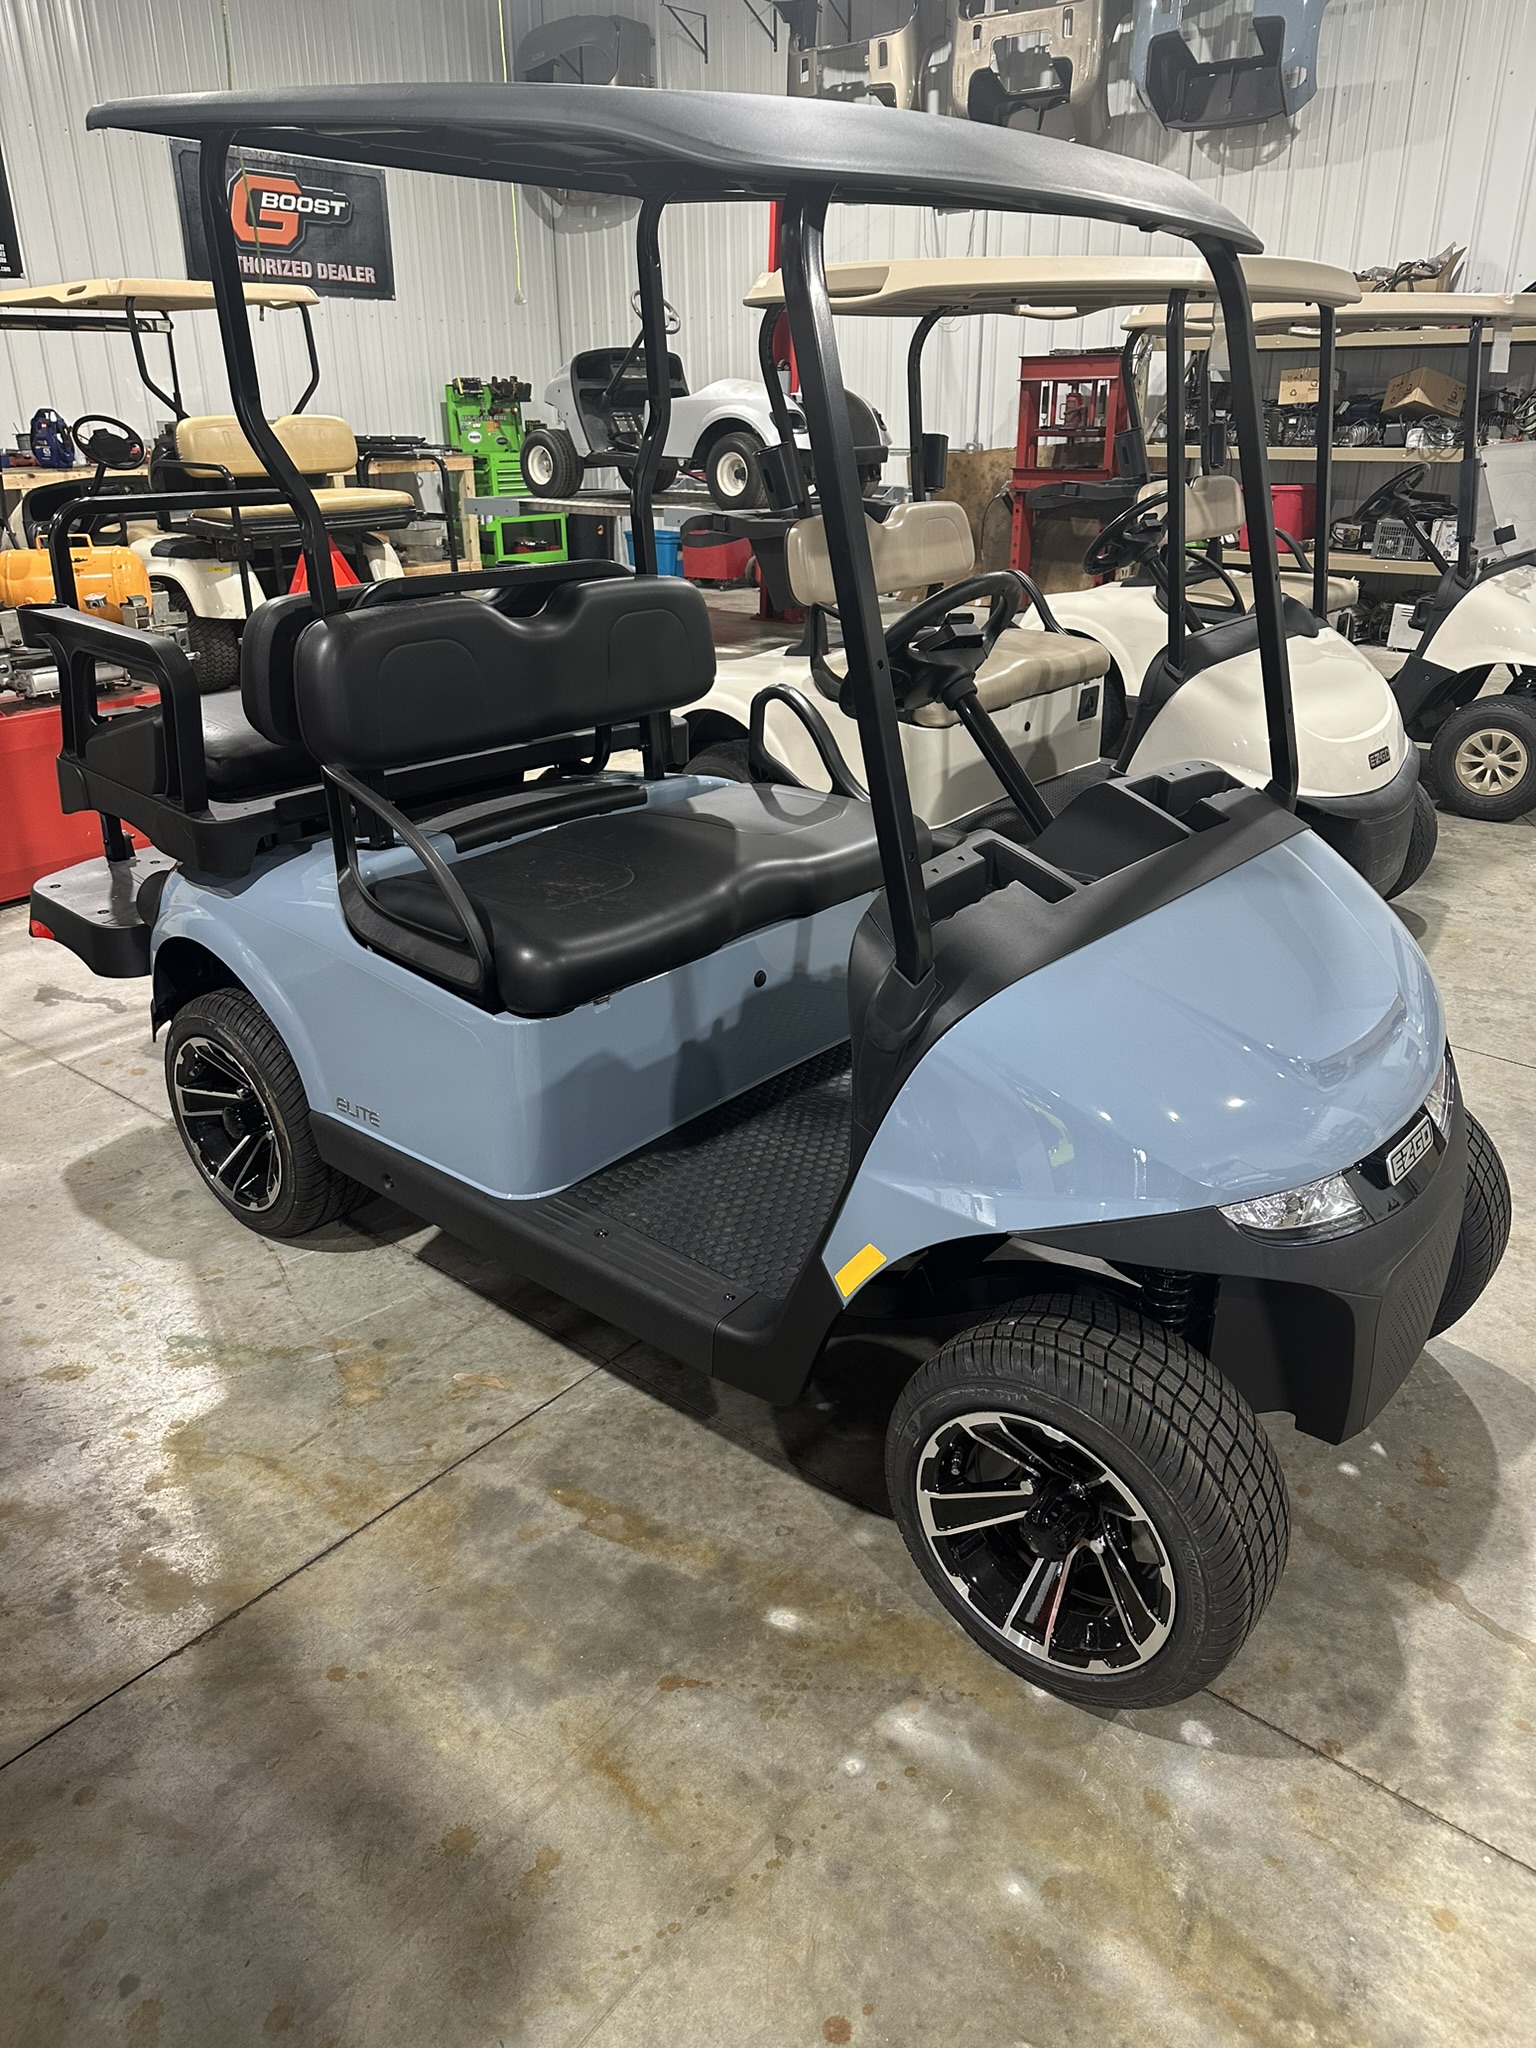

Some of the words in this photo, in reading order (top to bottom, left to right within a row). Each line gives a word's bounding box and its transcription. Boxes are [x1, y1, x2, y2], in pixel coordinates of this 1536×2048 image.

[261, 191, 347, 217] BOOST
[237, 255, 312, 278] THORIZED
[318, 262, 376, 284] DEALER
